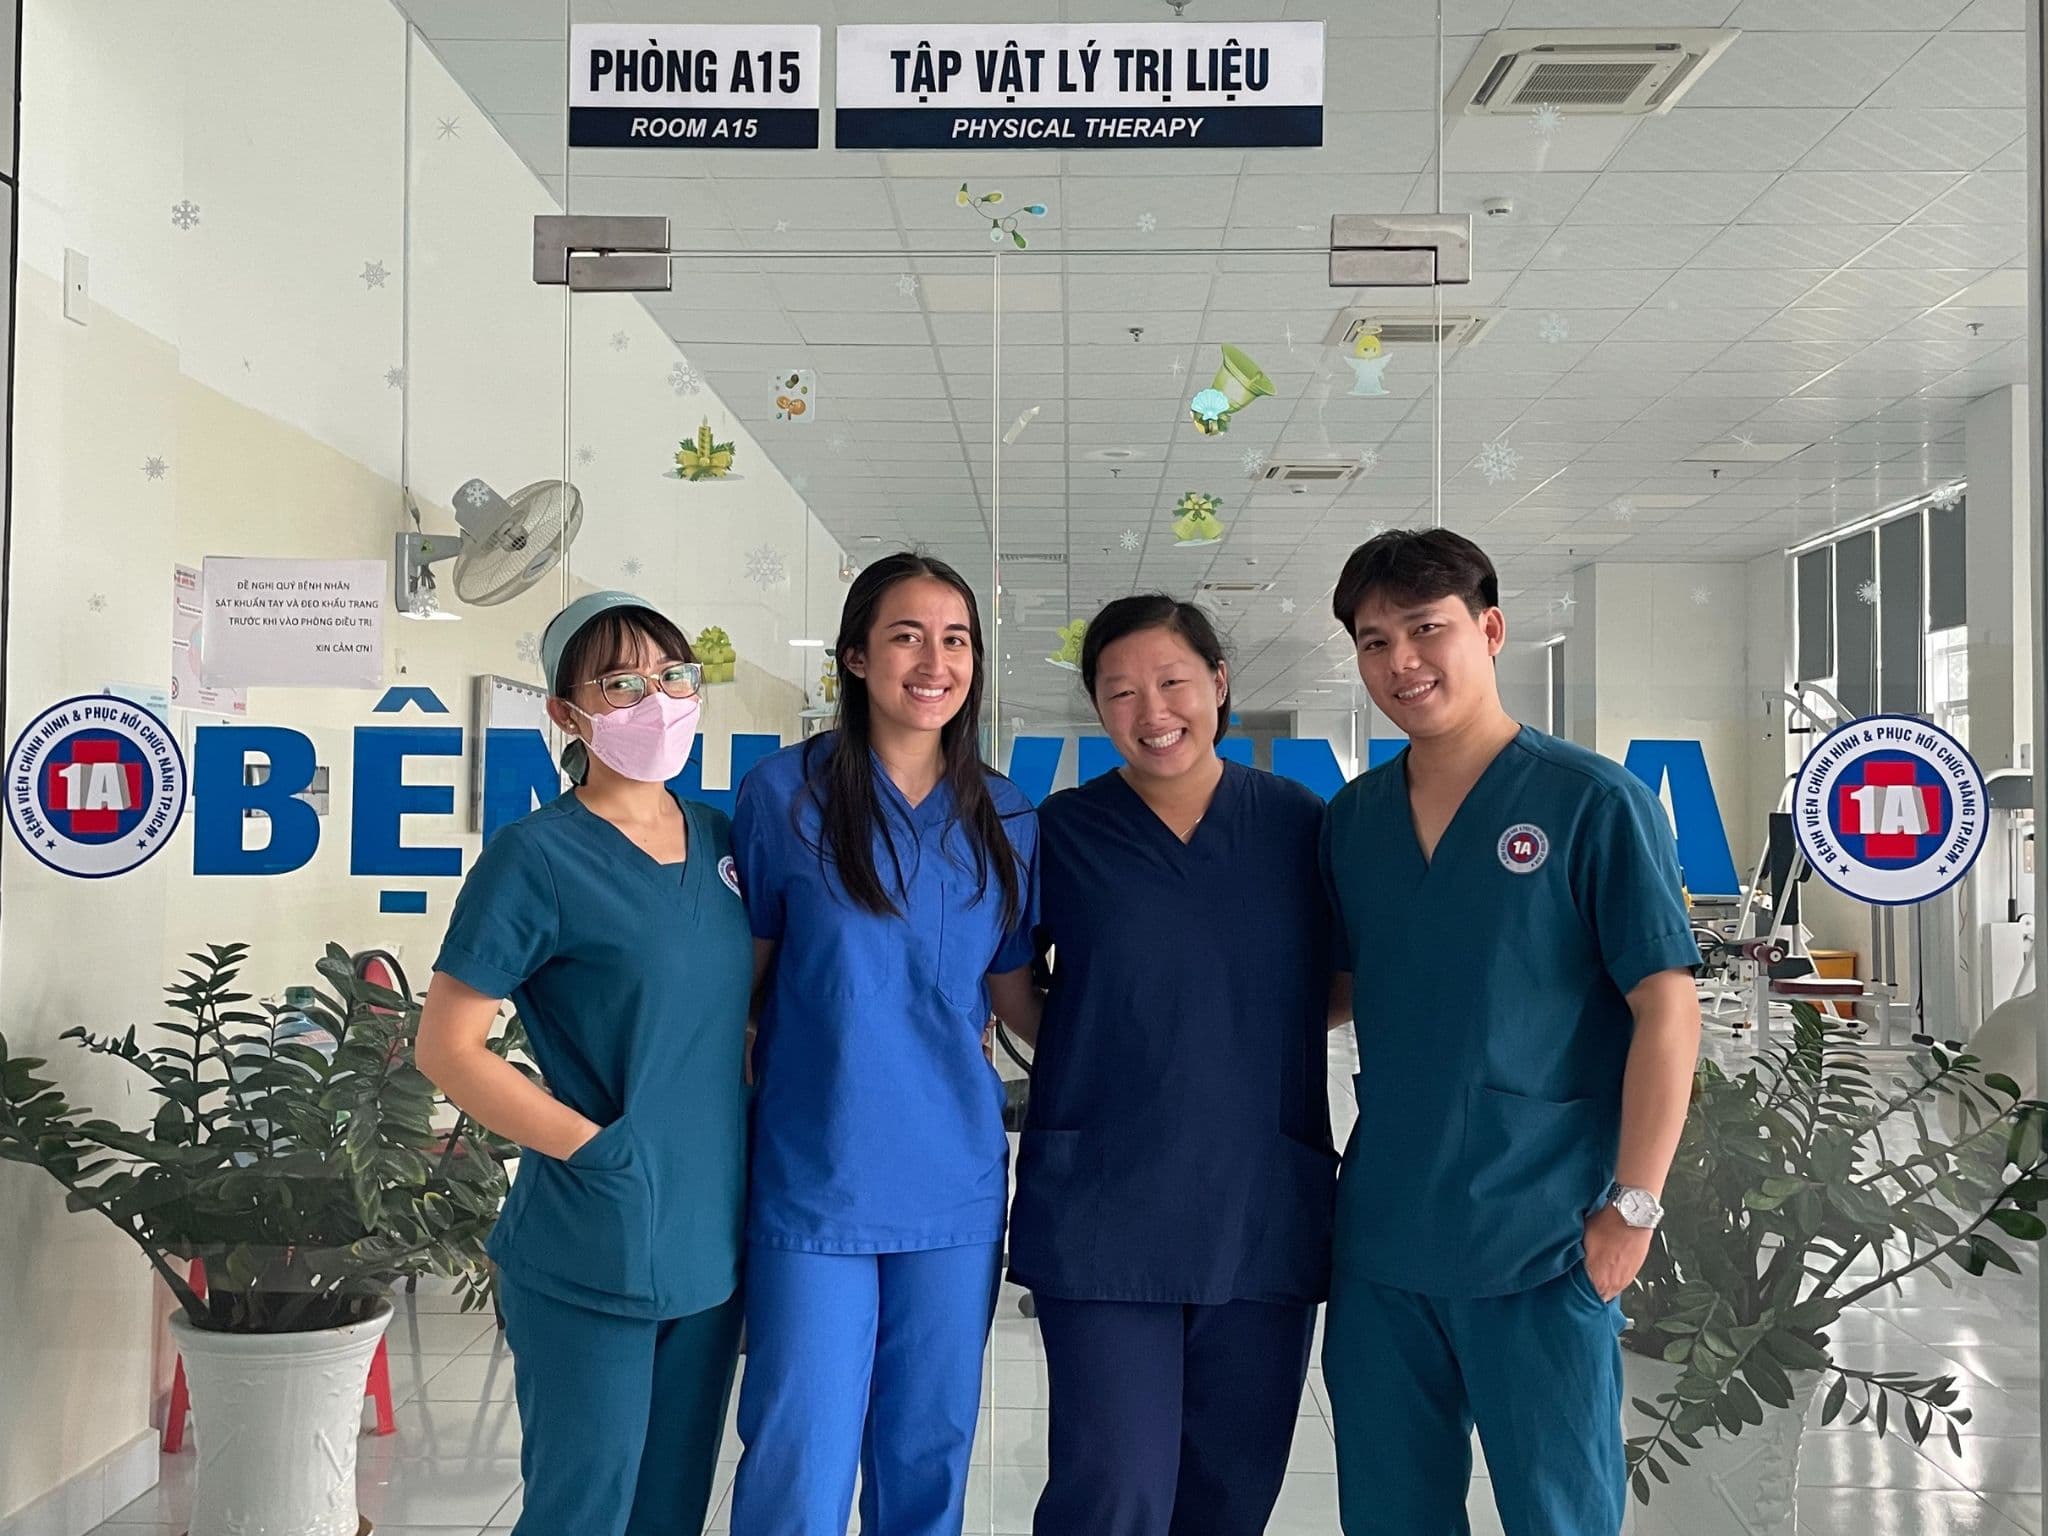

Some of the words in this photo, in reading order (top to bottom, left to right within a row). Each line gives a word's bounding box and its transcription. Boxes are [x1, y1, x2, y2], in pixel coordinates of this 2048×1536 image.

[590, 39, 717, 93] PHÒNG
[730, 50, 801, 93] A15
[891, 42, 961, 103] TẬP
[976, 42, 1046, 103] VẬT
[1058, 40, 1100, 93] LÝ
[1114, 48, 1172, 101] TRỊ
[1187, 39, 1270, 101] LIỆU
[630, 118, 706, 138] ROOM
[711, 118, 758, 138] A15
[951, 117, 1077, 139] PHYSICAL
[1085, 117, 1204, 139] THERAPY
[268, 600, 284, 608] TAY
[349, 600, 379, 609] TRANG
[263, 618, 277, 626] KHI
[316, 644, 330, 653] XIN
[41, 714, 70, 739] HÌNH
[72, 710, 82, 722] &
[85, 706, 119, 722] PHỤC
[139, 726, 166, 756] CHỨC
[1830, 734, 1860, 759] HÌNH
[1863, 730, 1873, 743] &
[1877, 727, 1913, 743] PHỤC
[158, 756, 175, 792] NĂNG
[1936, 747, 1965, 779] CHỨC
[15, 775, 32, 805] VIỆN
[58, 762, 132, 811] 1A
[1957, 780, 1976, 816] NĂNG
[20, 806, 45, 839] BỆNH
[144, 795, 173, 839] TP.HCM
[1803, 798, 1821, 828] VIỆN
[1850, 785, 1930, 835] 1A
[1513, 840, 1532, 856] 1A
[1811, 831, 1838, 864] BỆNH
[1944, 820, 1975, 865] TP.HCM
